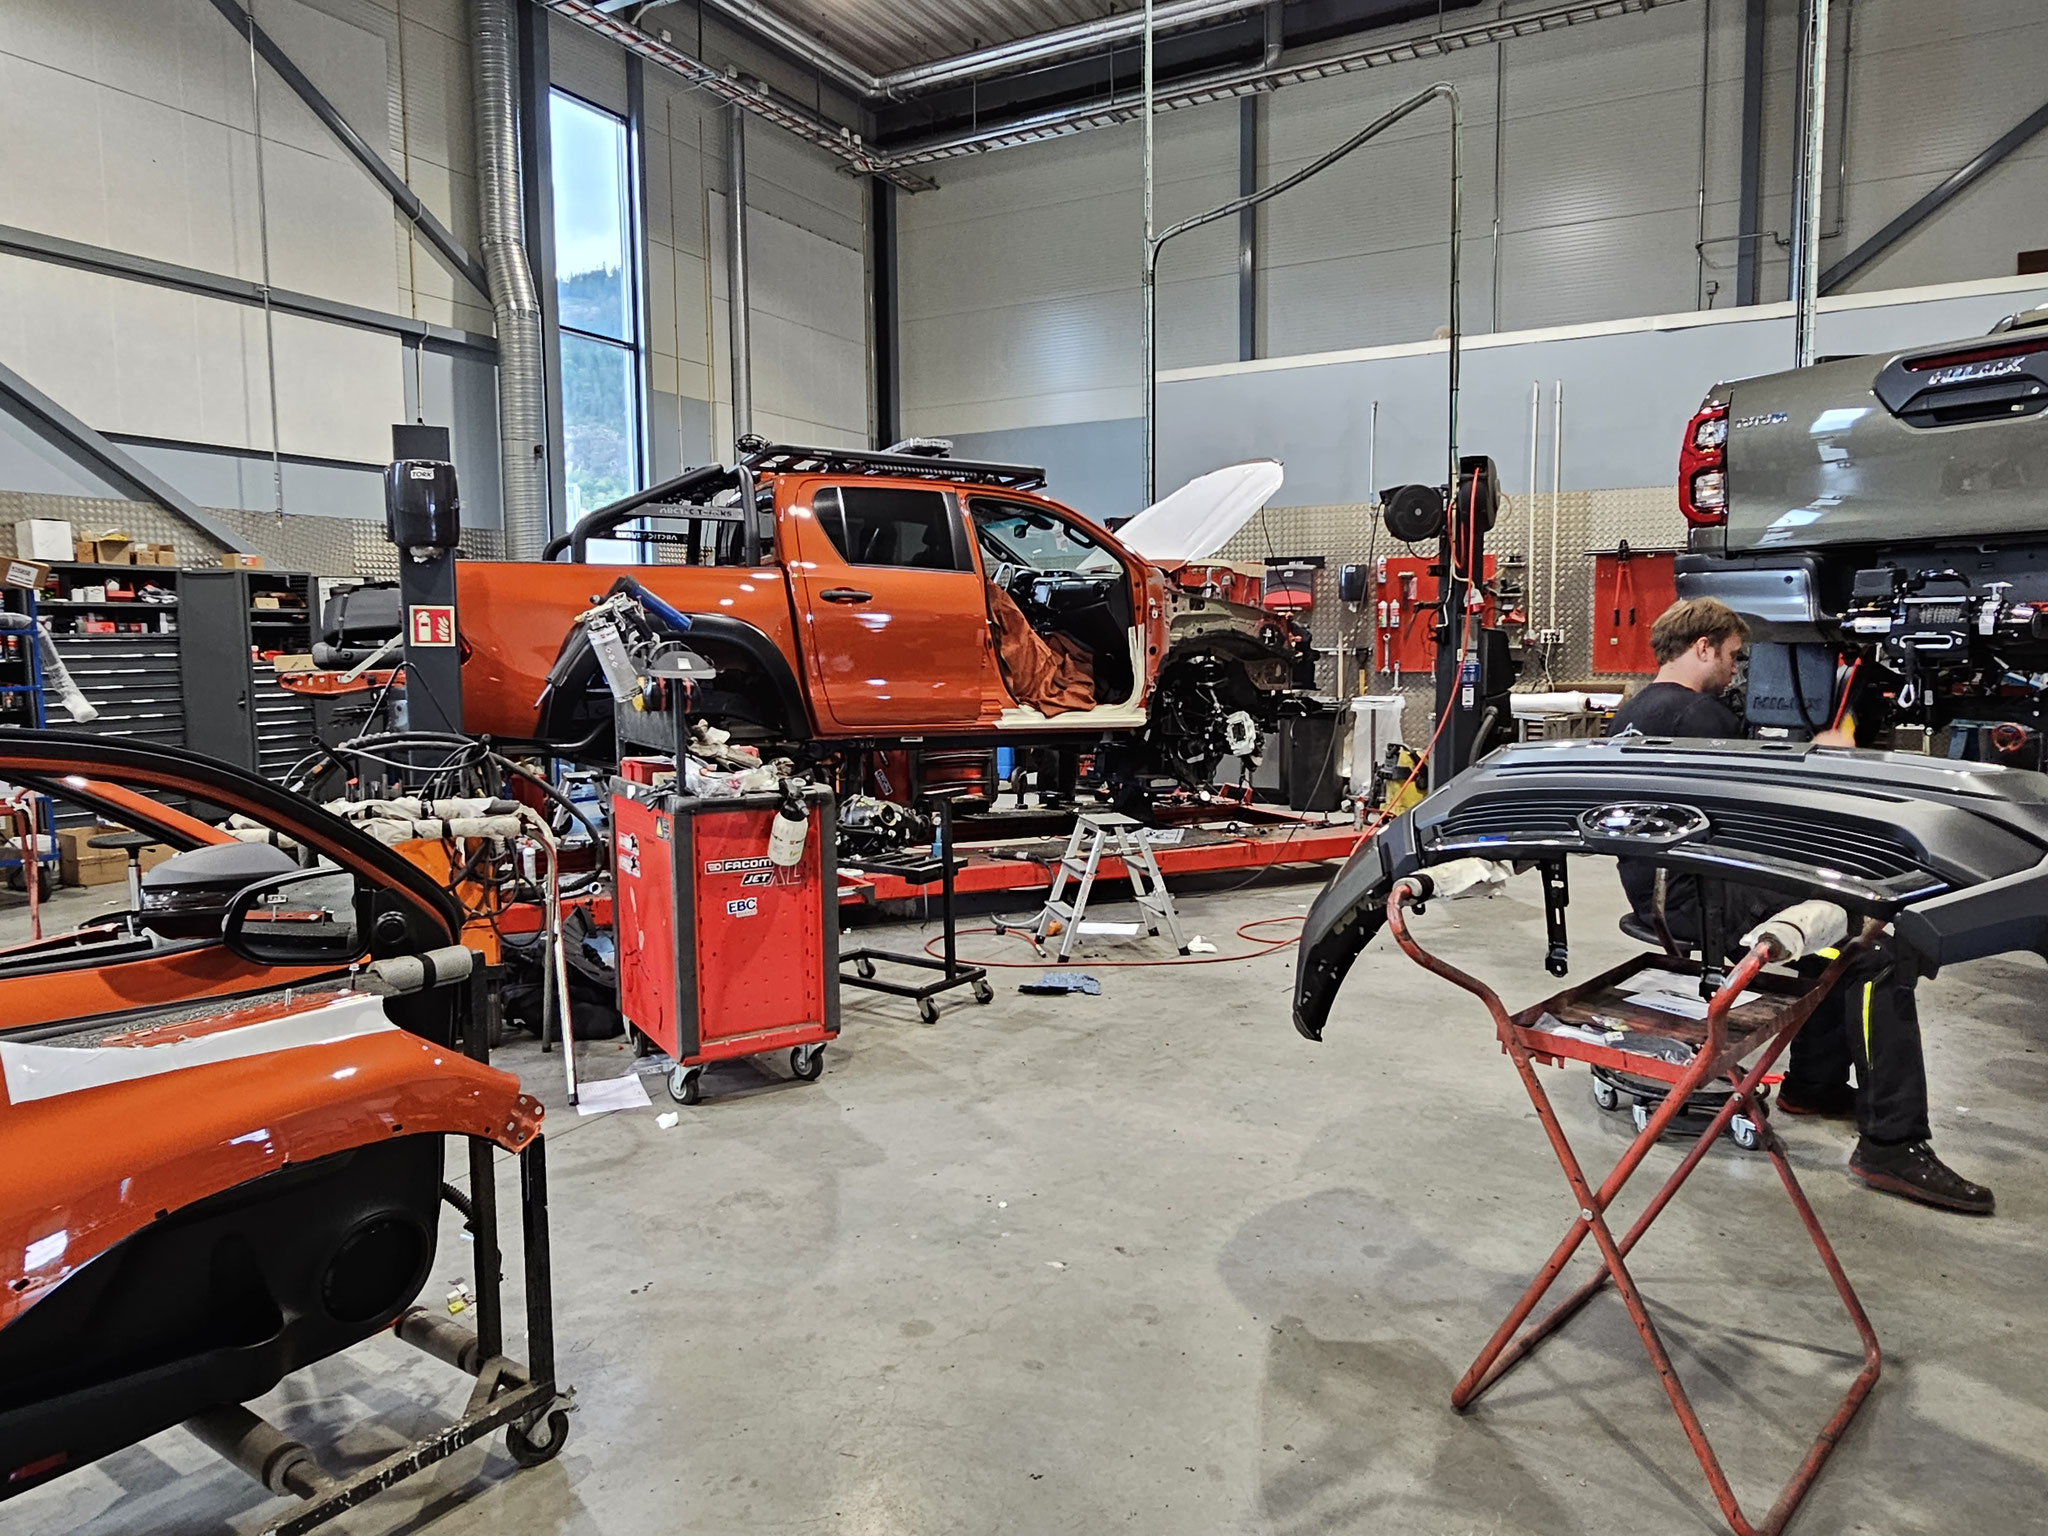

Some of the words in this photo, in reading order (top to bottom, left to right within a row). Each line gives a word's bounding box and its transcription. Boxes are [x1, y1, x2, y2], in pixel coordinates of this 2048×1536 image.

[724, 858, 773, 871] FACOM
[744, 873, 771, 884] JET
[729, 899, 756, 913] EBC
